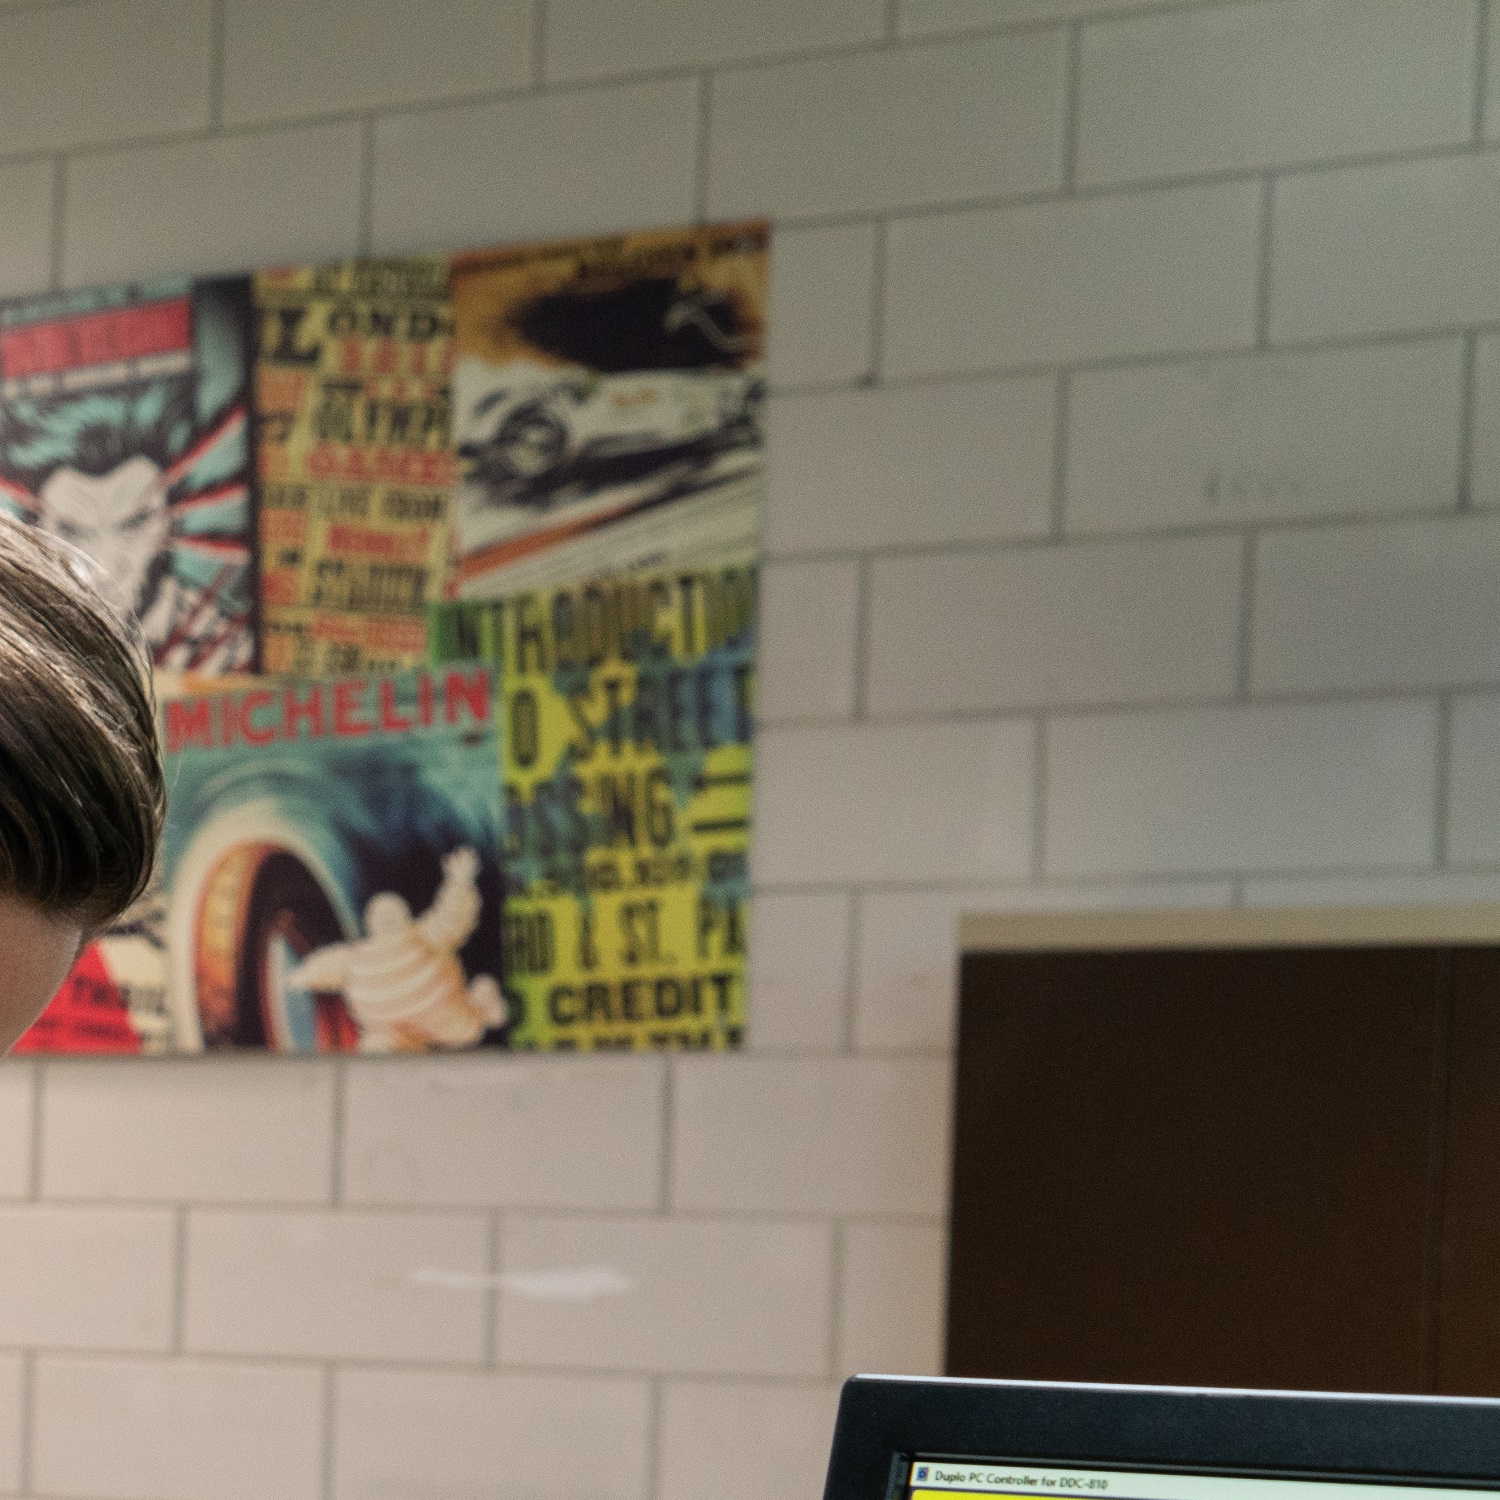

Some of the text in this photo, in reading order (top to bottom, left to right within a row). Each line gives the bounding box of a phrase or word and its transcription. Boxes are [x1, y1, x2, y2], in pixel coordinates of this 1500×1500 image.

[165, 668, 489, 755] MICHELIN
[547, 973, 741, 1027] CREDIT
[935, 1470, 966, 1484] Duplo
[968, 1472, 984, 1484] PC
[987, 1473, 1038, 1487] Controller
[1041, 1476, 1056, 1487] for
